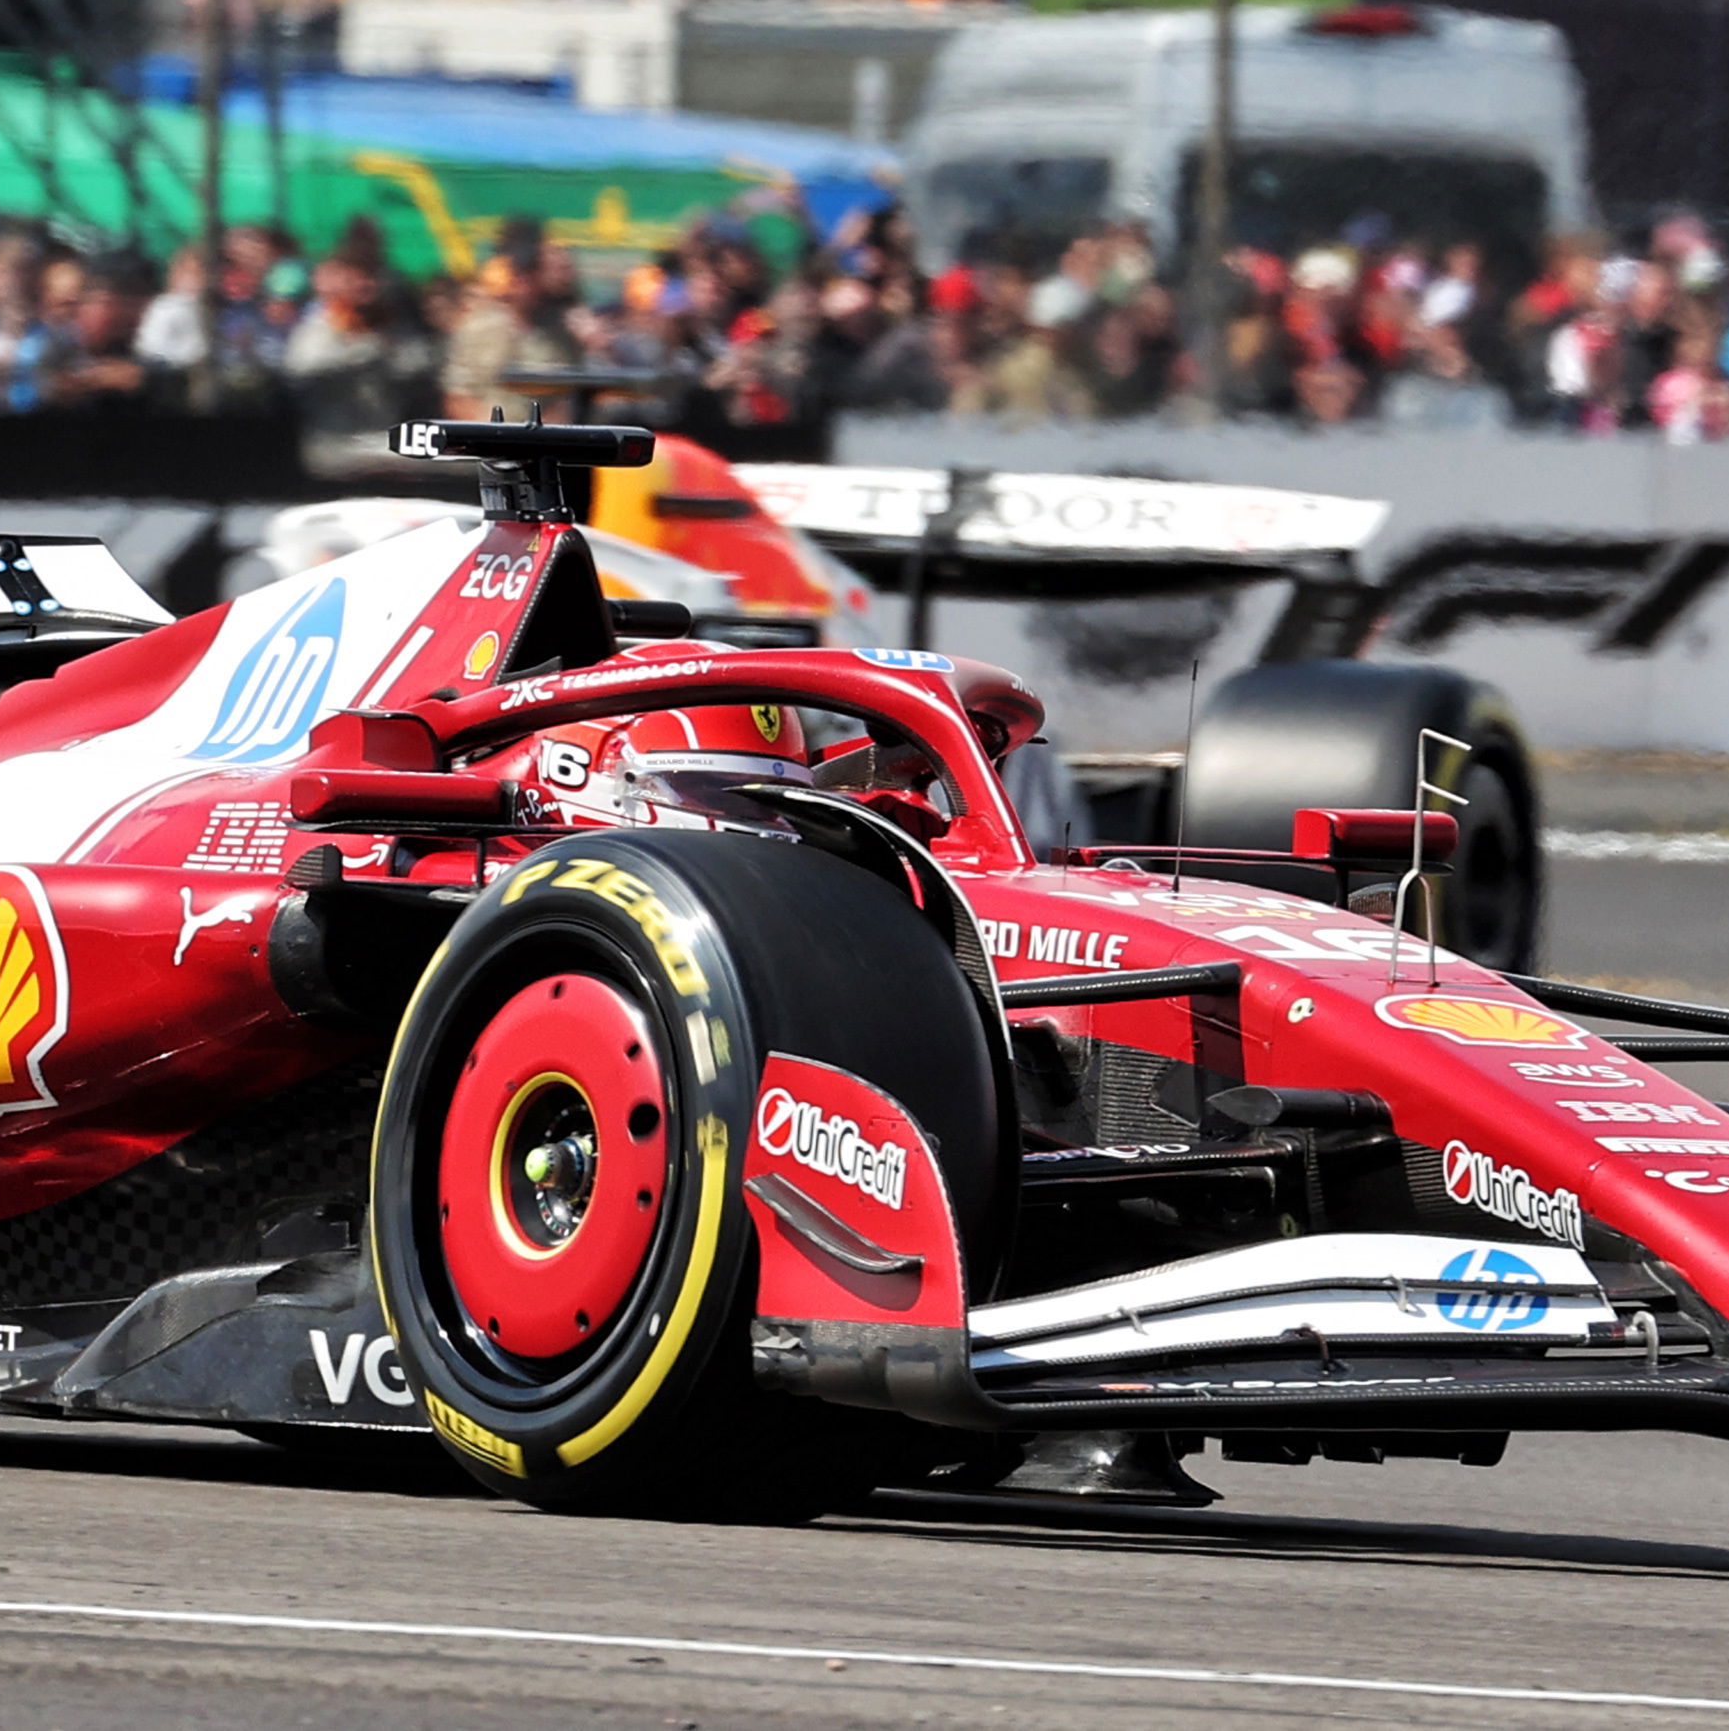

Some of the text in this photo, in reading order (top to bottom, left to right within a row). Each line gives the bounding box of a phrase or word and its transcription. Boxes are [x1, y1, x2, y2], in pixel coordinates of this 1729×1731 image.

[399, 422, 440, 457] LEC
[848, 483, 1176, 532] TDOR
[459, 553, 532, 601] ZCG
[212, 581, 335, 764] hp
[561, 659, 714, 691] TECHNOLOGY
[538, 738, 592, 788] 16
[687, 758, 715, 766] MILLE
[182, 801, 292, 872] IBM
[501, 858, 711, 998] P ZERO
[1026, 925, 1130, 970] MILLE
[1213, 924, 1462, 966] 16
[1509, 1061, 1629, 1081] aws
[1555, 1099, 1722, 1126] IBM
[791, 1102, 909, 1211] UniCredit
[1470, 1152, 1587, 1253] UniCredit
